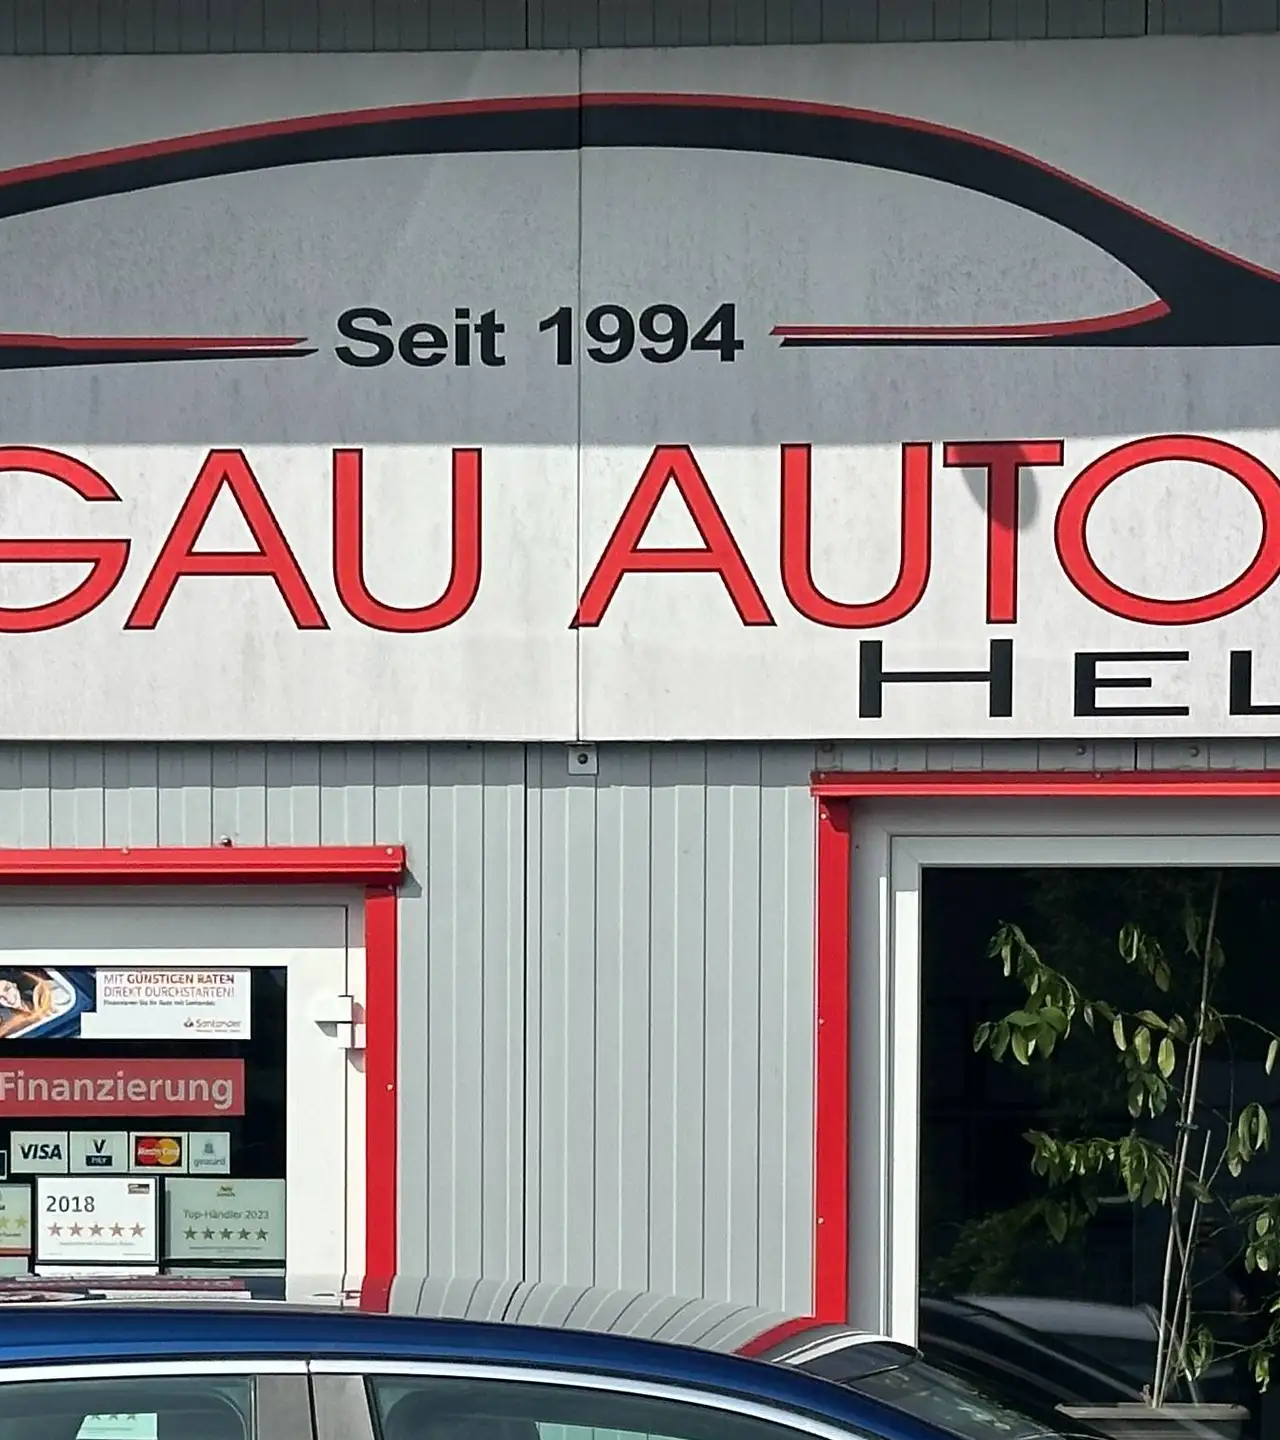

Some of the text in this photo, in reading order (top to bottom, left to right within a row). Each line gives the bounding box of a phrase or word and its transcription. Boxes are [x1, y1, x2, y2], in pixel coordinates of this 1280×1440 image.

[334, 303, 745, 368] Seit 1994
[103, 971, 235, 984] MIT GÜNSTIGEN RATEN
[103, 986, 236, 998] DIREKT DURCHSTARTEN!
[19, 1144, 62, 1160] VISA
[92, 1139, 107, 1154] V
[46, 1195, 95, 1213] 2018
[183, 1209, 270, 1220] Top-Händler 2023
